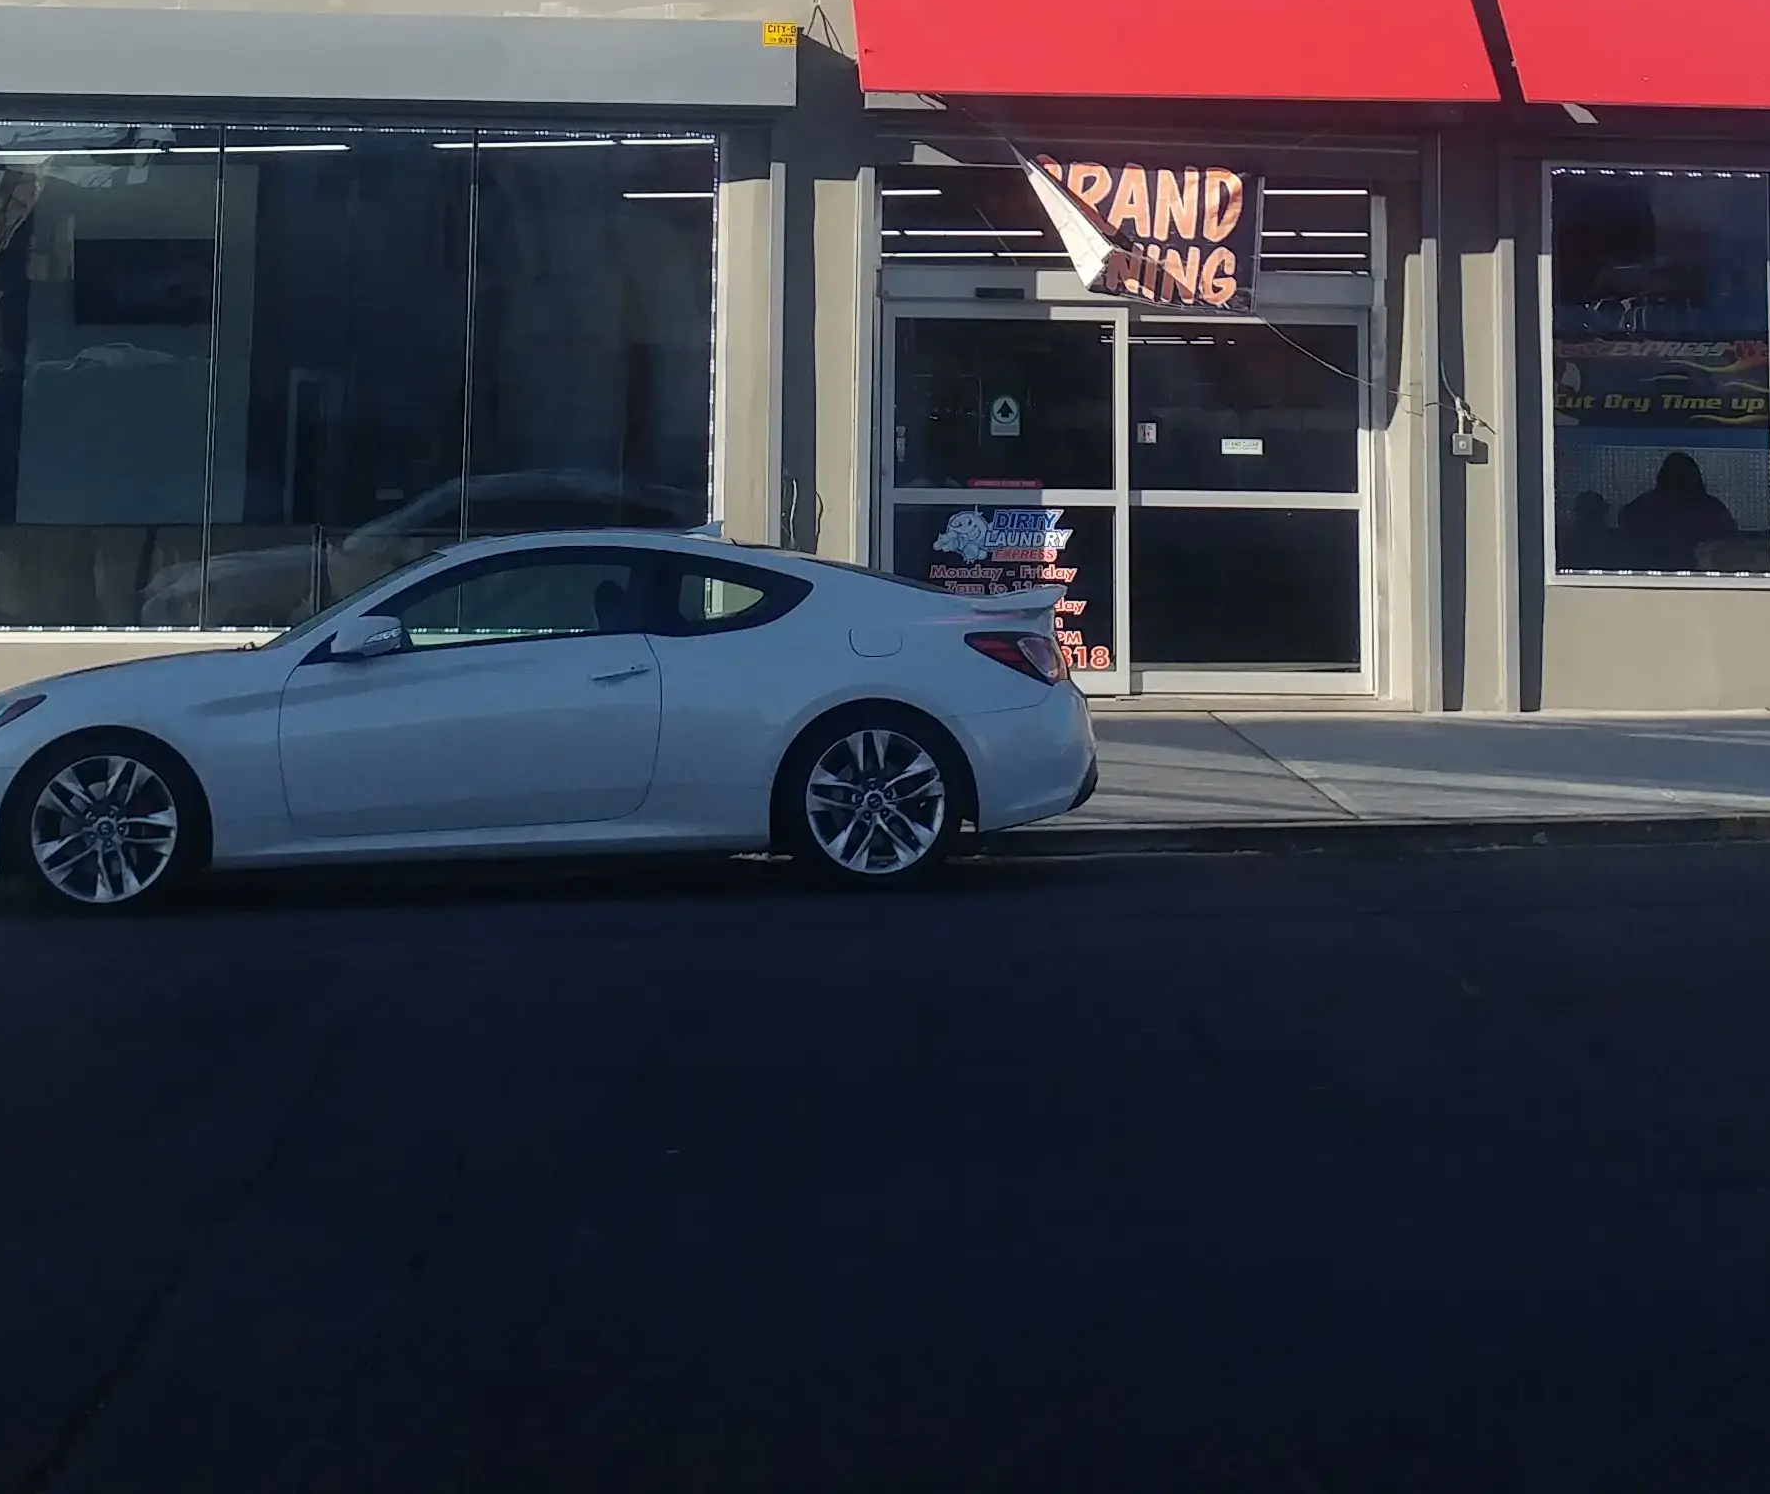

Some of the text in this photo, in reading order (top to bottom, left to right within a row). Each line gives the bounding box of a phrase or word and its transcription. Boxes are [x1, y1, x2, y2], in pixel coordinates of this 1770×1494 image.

[1104, 242, 1237, 306] NING
[1604, 394, 1651, 412] Dry
[1662, 394, 1722, 409] Time
[993, 509, 1065, 530] DIRTY
[984, 529, 1074, 549] LAUNDRY
[991, 548, 1058, 562] EXPRESS
[929, 565, 1003, 582] Monday
[1020, 564, 1078, 582] Friday
[988, 581, 1008, 595] to
[1054, 596, 1087, 615] day
